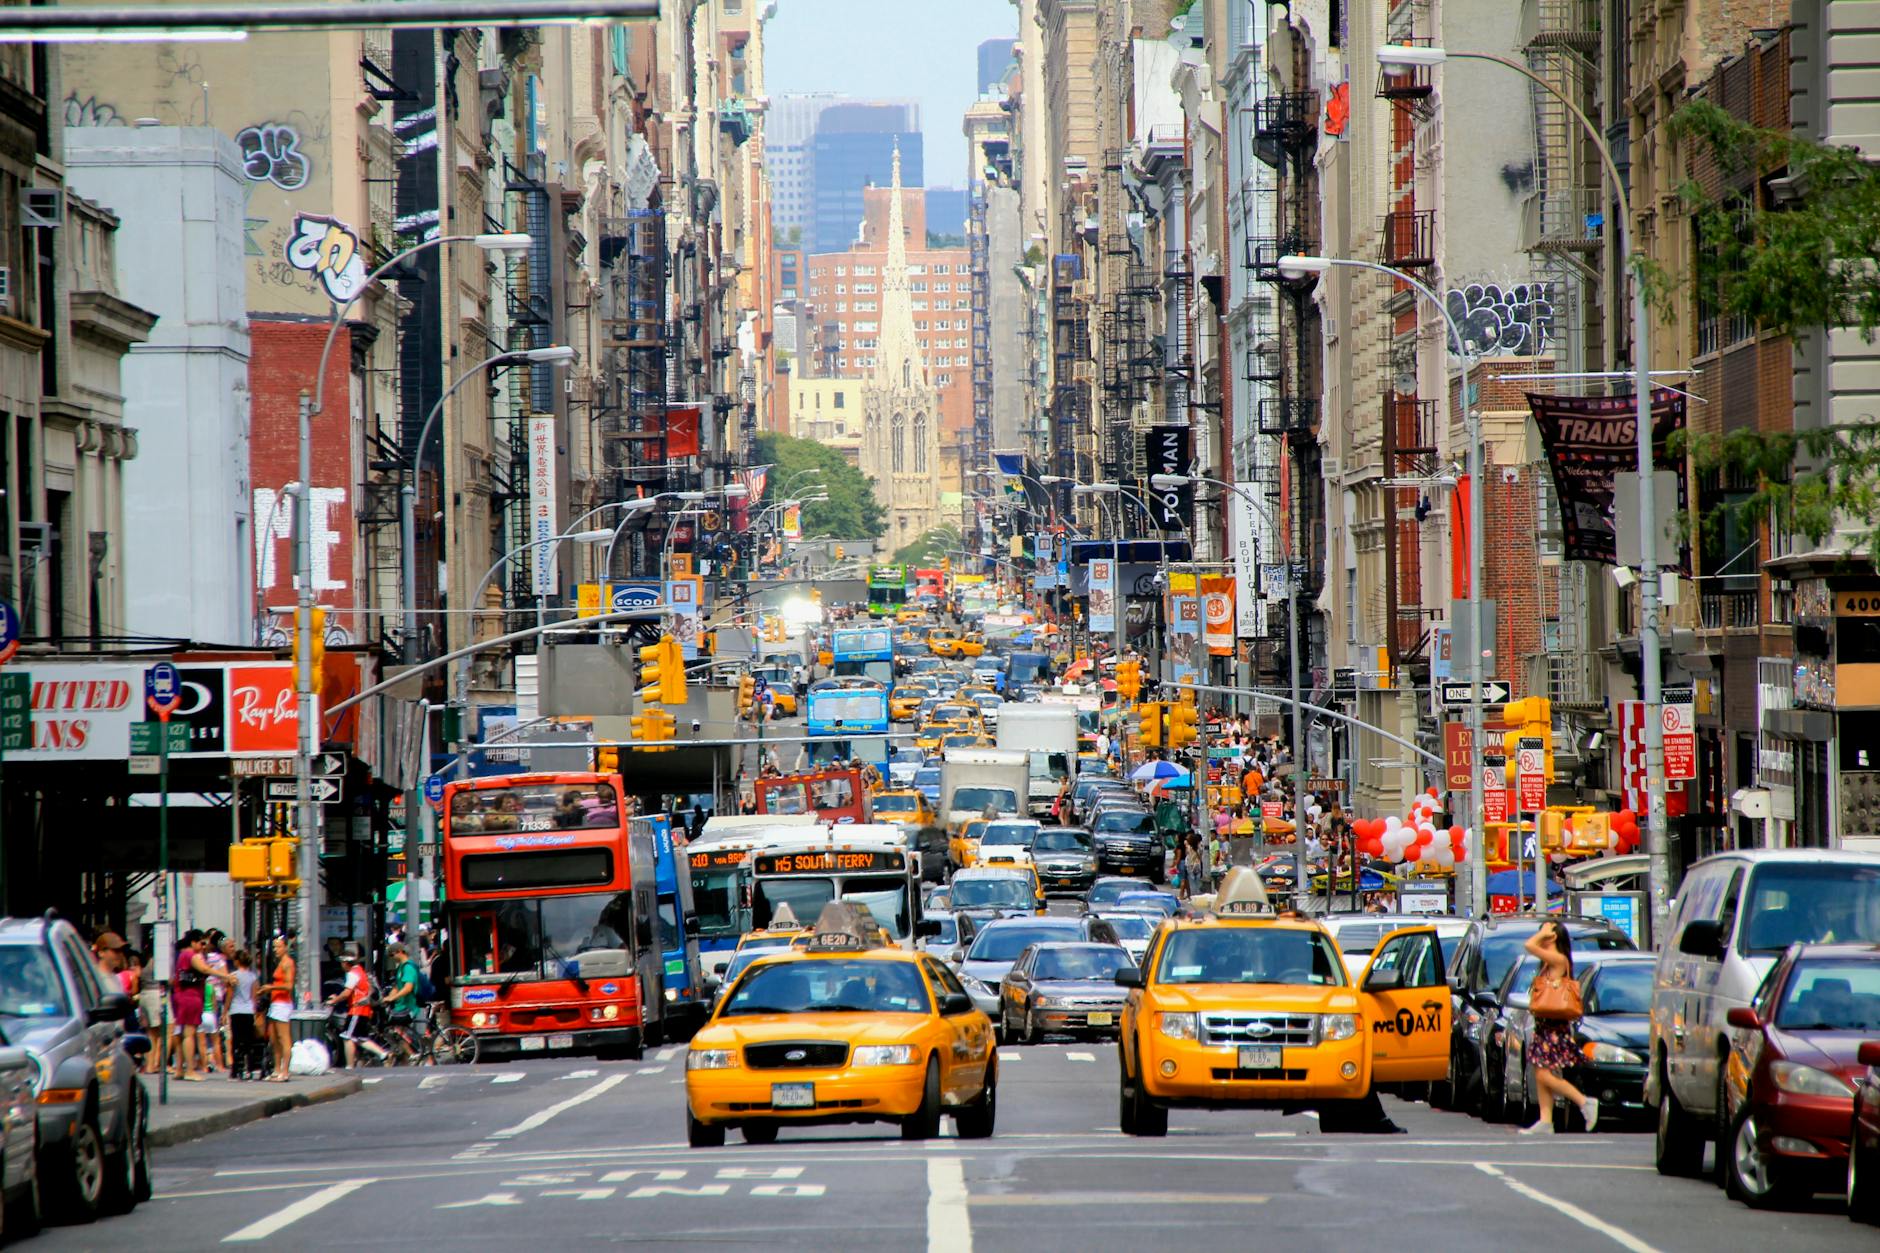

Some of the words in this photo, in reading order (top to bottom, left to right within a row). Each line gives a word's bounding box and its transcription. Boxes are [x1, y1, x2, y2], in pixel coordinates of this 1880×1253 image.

[1558, 416, 1661, 443] TRANST
[1448, 689, 1468, 698] ONE
[232, 760, 274, 774] WALKER
[278, 760, 292, 774] ST
[276, 784, 297, 794] ONE
[1307, 780, 1331, 790] CANAL
[1334, 780, 1344, 790] ST
[692, 853, 709, 867] x10
[775, 856, 791, 872] M5
[795, 854, 833, 870] SOUTH
[838, 853, 873, 868] FERRY
[821, 935, 846, 945] 6E20
[1395, 1007, 1441, 1037] TAXI
